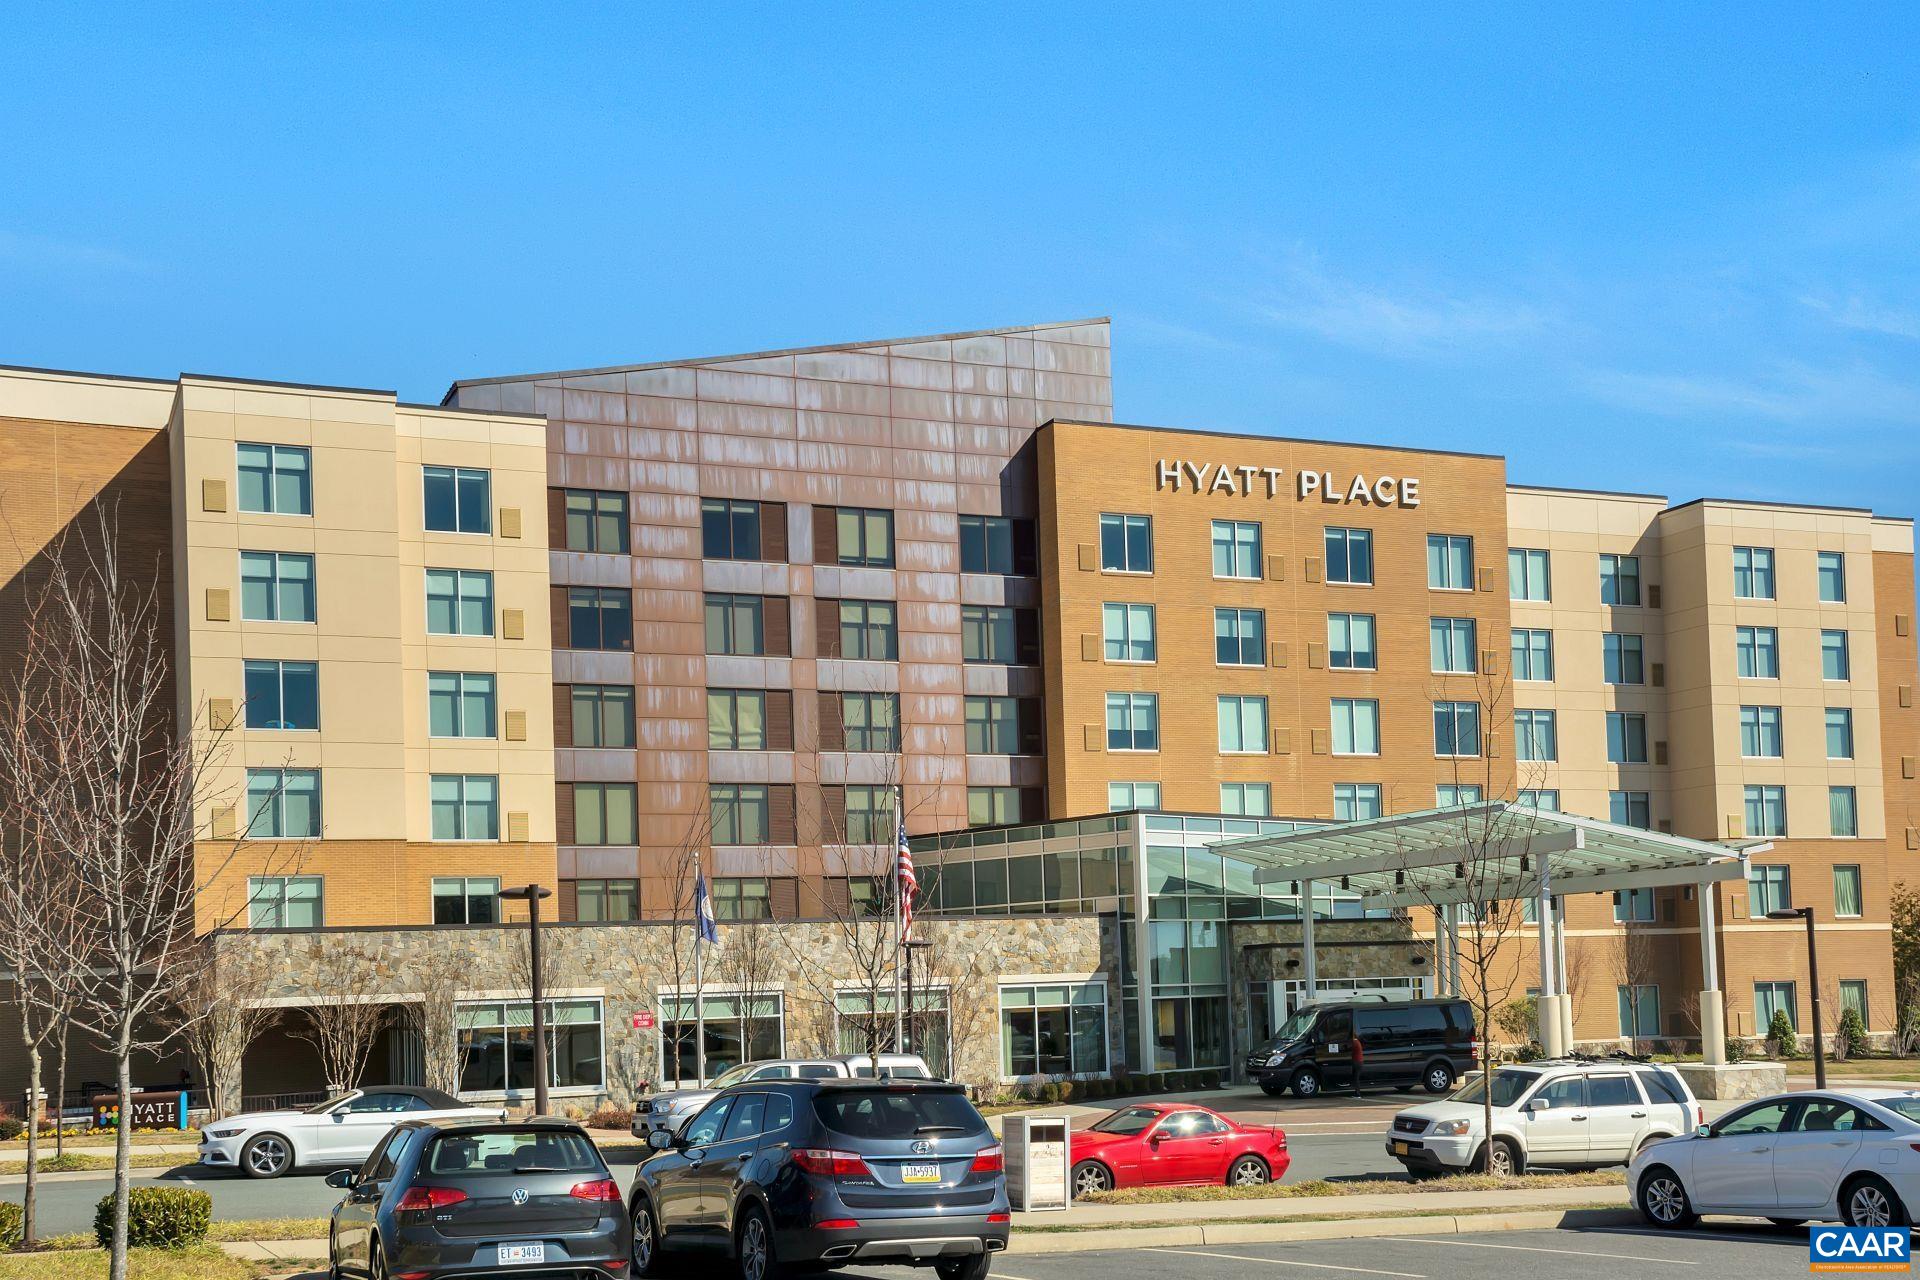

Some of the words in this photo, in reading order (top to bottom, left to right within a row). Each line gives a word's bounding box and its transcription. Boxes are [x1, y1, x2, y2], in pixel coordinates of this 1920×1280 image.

[1158, 458, 1283, 497] HYATT
[1299, 469, 1421, 506] PLACE
[134, 1113, 175, 1124] LACE
[521, 1246, 542, 1257] 3493
